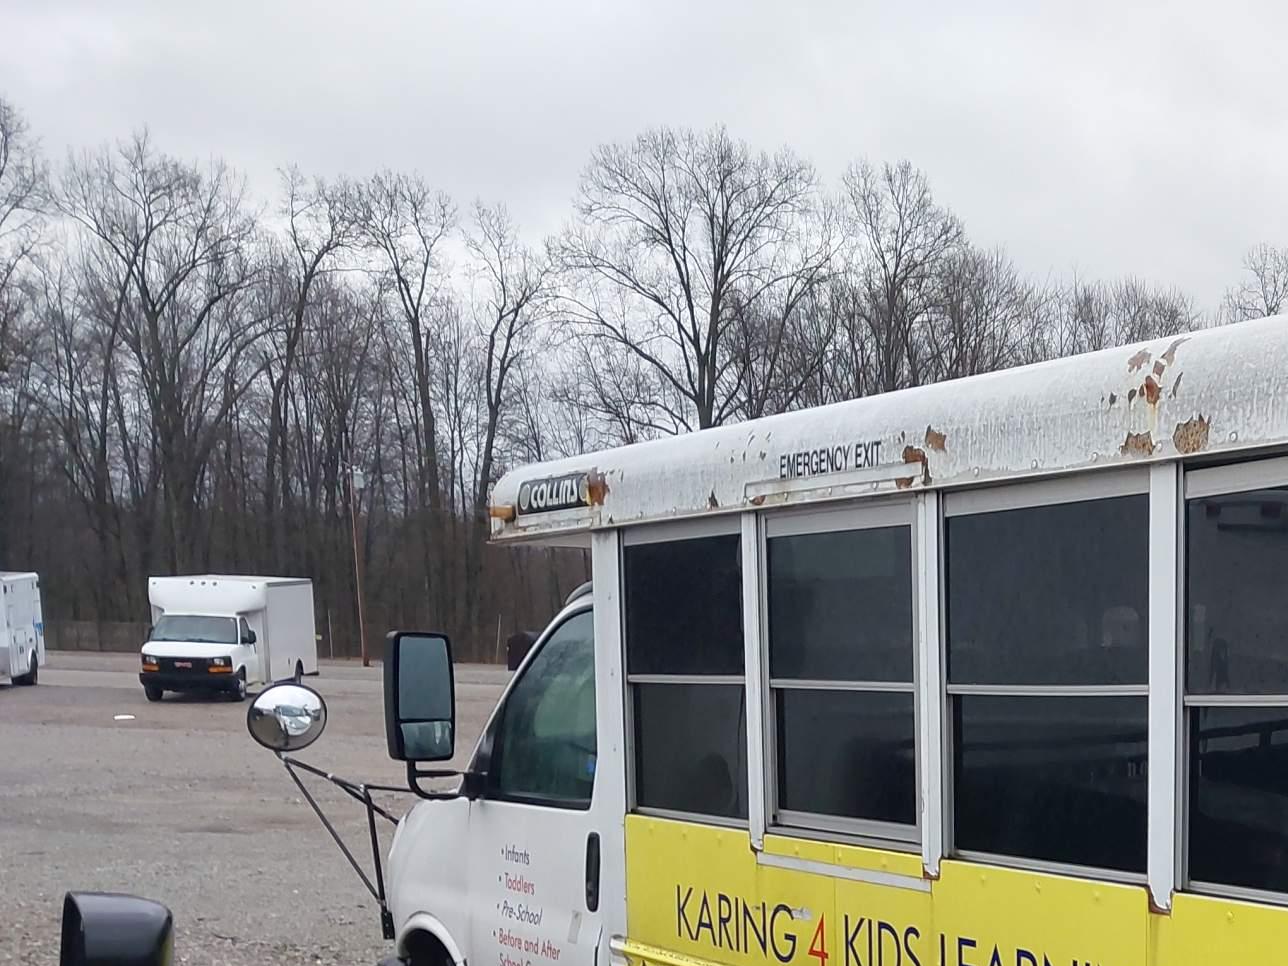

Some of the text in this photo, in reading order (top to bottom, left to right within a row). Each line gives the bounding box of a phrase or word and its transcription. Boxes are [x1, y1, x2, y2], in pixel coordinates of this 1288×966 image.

[779, 440, 882, 479] EMERGENCY EXIT
[530, 478, 578, 509] COLLINS
[504, 845, 530, 866] Infants
[504, 872, 535, 896] Toddlers
[501, 900, 543, 925] Pre-School
[674, 884, 798, 963] KARING
[498, 927, 561, 961] Before and After
